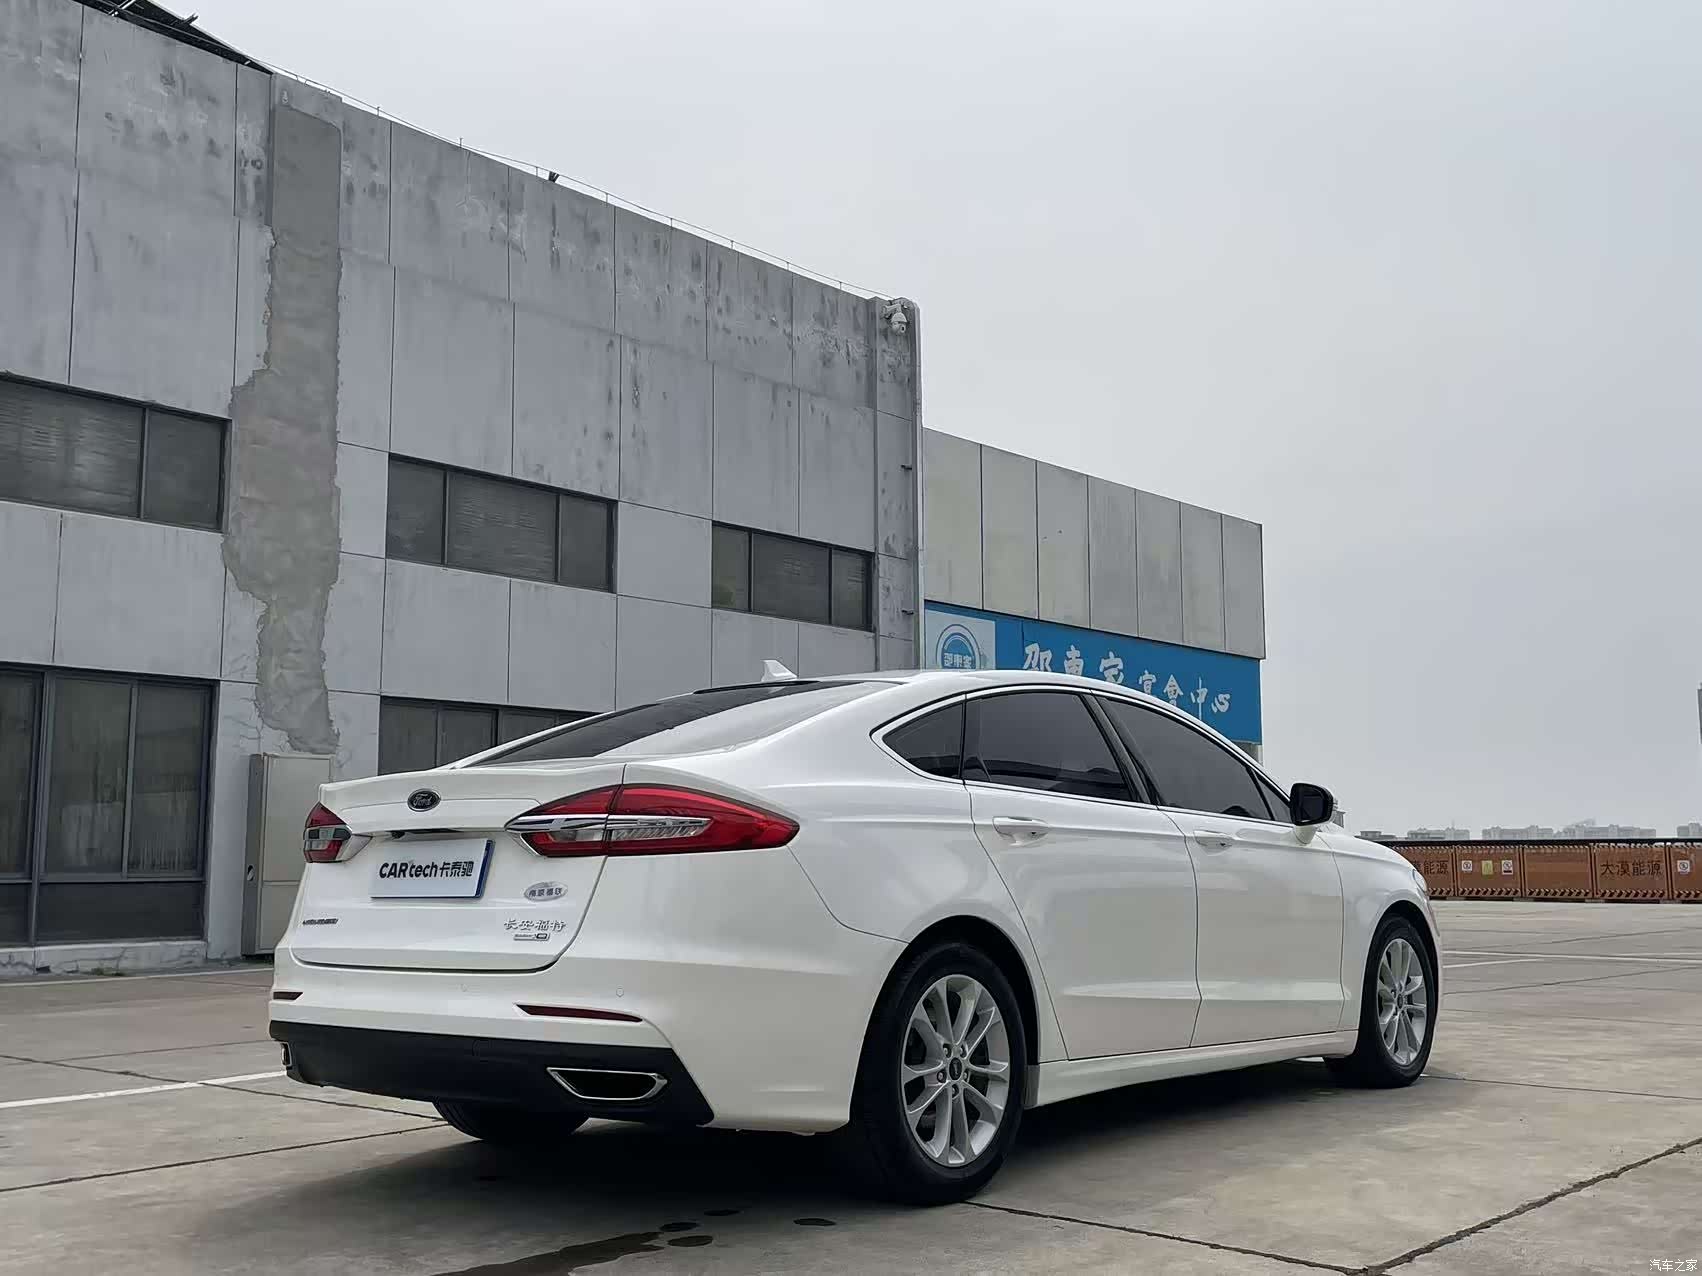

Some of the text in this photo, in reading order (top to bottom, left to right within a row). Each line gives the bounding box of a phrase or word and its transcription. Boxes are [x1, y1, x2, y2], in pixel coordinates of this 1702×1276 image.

[1600, 860, 1663, 876] 大漠能源
[503, 919, 566, 932] 长安福特
